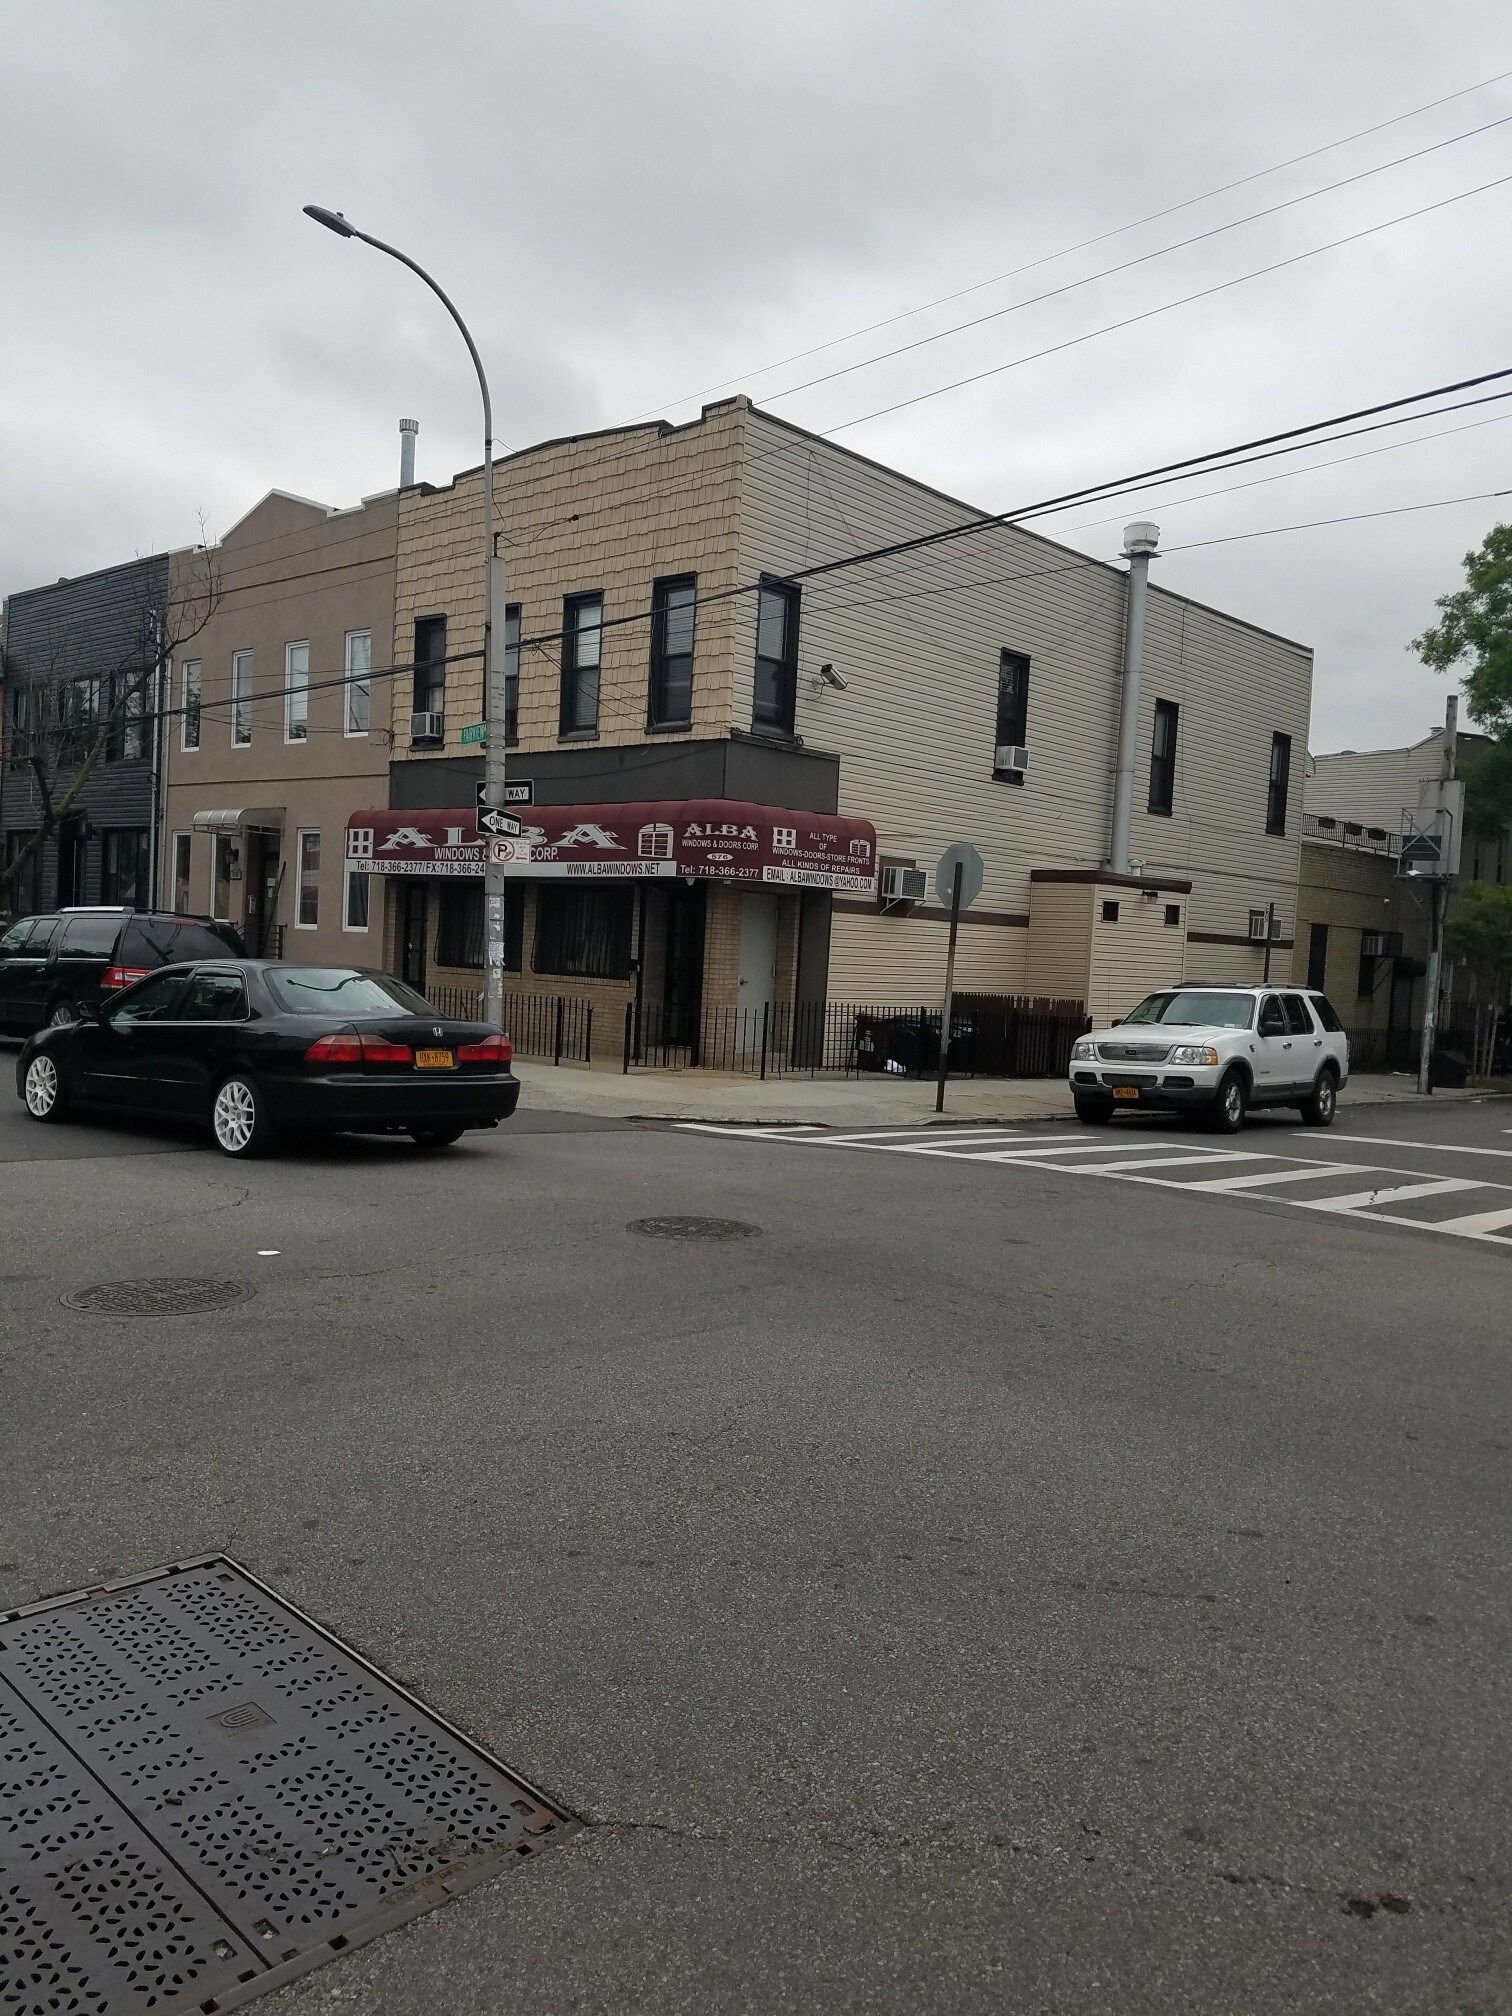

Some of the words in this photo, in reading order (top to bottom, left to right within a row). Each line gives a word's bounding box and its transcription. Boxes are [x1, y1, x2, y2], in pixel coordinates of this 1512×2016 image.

[507, 788, 526, 799] WAY
[489, 815, 504, 828] ONE
[506, 821, 518, 833] WAY
[683, 823, 759, 841] ALBA
[809, 832, 821, 841] ALL
[822, 833, 837, 843] TYPE
[682, 838, 712, 848] WINDOWS
[712, 840, 718, 848] &
[718, 840, 742, 850] DOORS
[742, 841, 760, 851] CORP.
[818, 842, 827, 850] OF
[434, 848, 480, 861] WINDOWS
[531, 847, 559, 861] CORP.
[847, 856, 870, 865] FRONTS
[356, 861, 370, 872] Tel:
[566, 862, 660, 877] WWW.ALBAWINDOWS.NET
[680, 864, 696, 874] Tel:
[698, 865, 759, 878] 718-366-2377
[782, 859, 796, 867] ALL
[797, 860, 819, 870] KINDS
[820, 863, 830, 871] OF
[831, 865, 860, 875] REPAIRS
[766, 867, 785, 881] EMAIL
